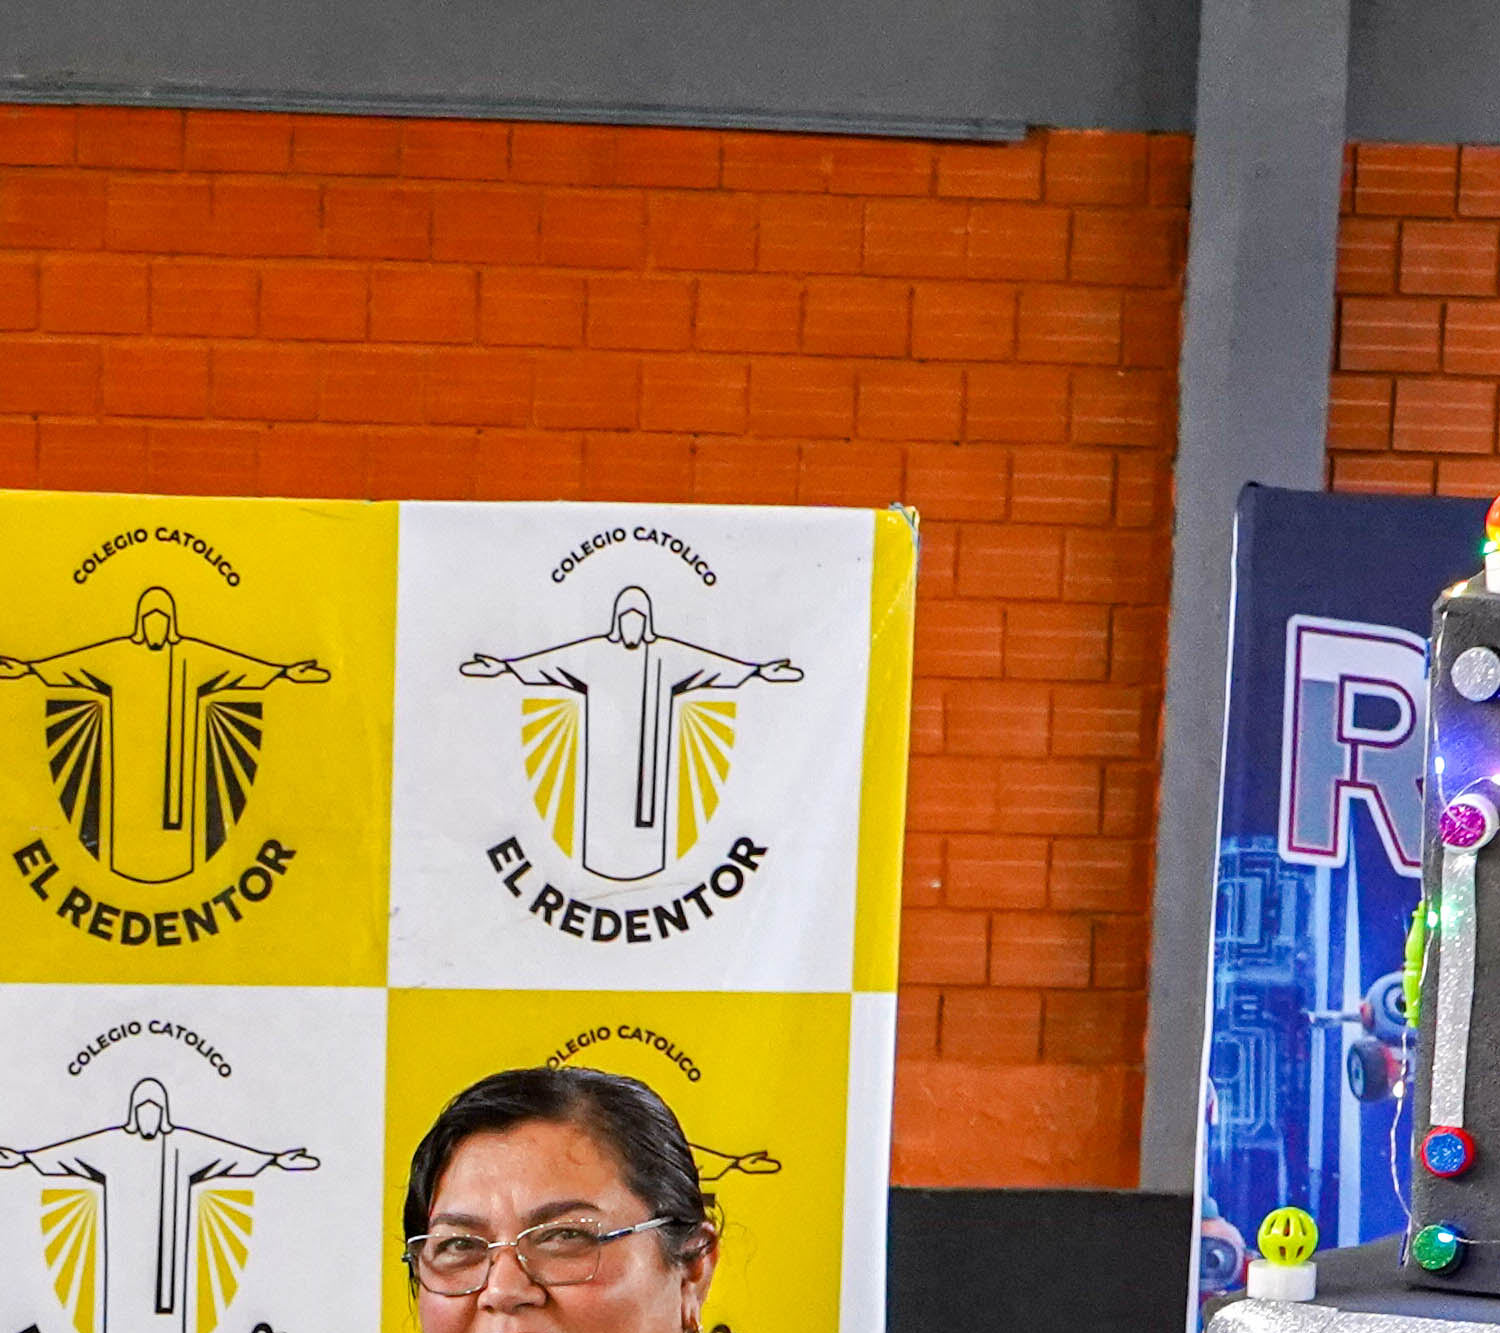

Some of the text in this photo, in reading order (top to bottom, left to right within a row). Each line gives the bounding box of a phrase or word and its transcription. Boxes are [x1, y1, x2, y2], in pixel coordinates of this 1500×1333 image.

[73, 527, 241, 587] COLEGIO CATOLICO
[551, 526, 717, 587] COLEGIO CATOLICO
[12, 838, 297, 947] EL REDENTOR
[486, 836, 768, 944] EL REDENTOR
[67, 1020, 232, 1078] COLEGIO CATOLICO
[545, 1025, 701, 1082] OLEGIO CATOLICO
